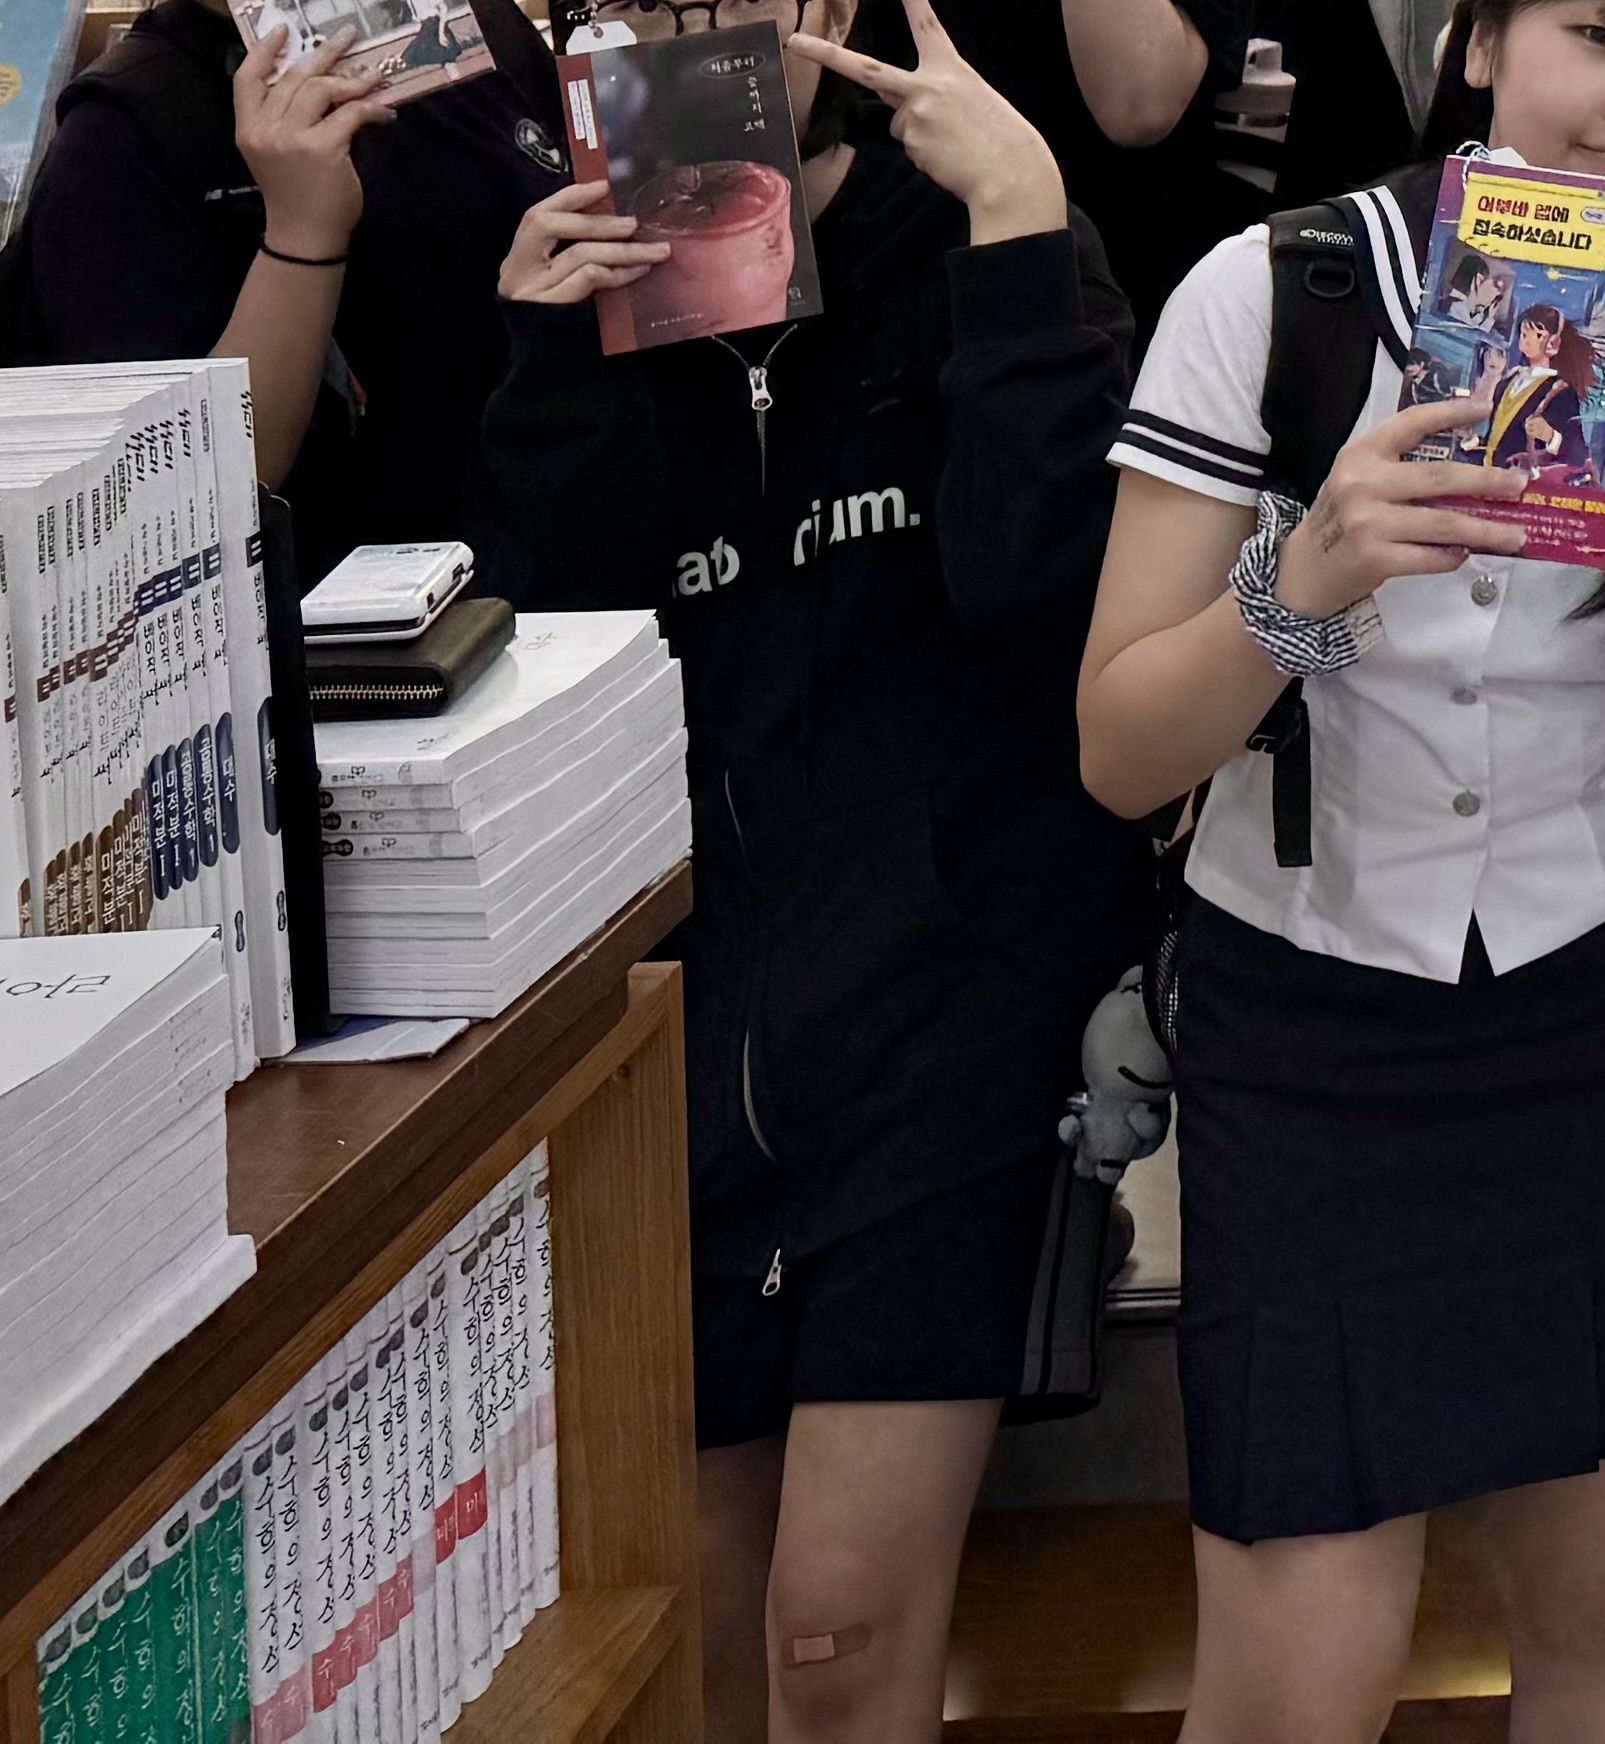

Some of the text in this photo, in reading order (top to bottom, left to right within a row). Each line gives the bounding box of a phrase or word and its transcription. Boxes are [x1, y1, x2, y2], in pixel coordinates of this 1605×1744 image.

[151, 779, 167, 848] 미적분
[165, 769, 180, 840] 미적분
[181, 750, 197, 841] 공통수학
[198, 737, 217, 828] 공통수학
[222, 754, 236, 802] 대수
